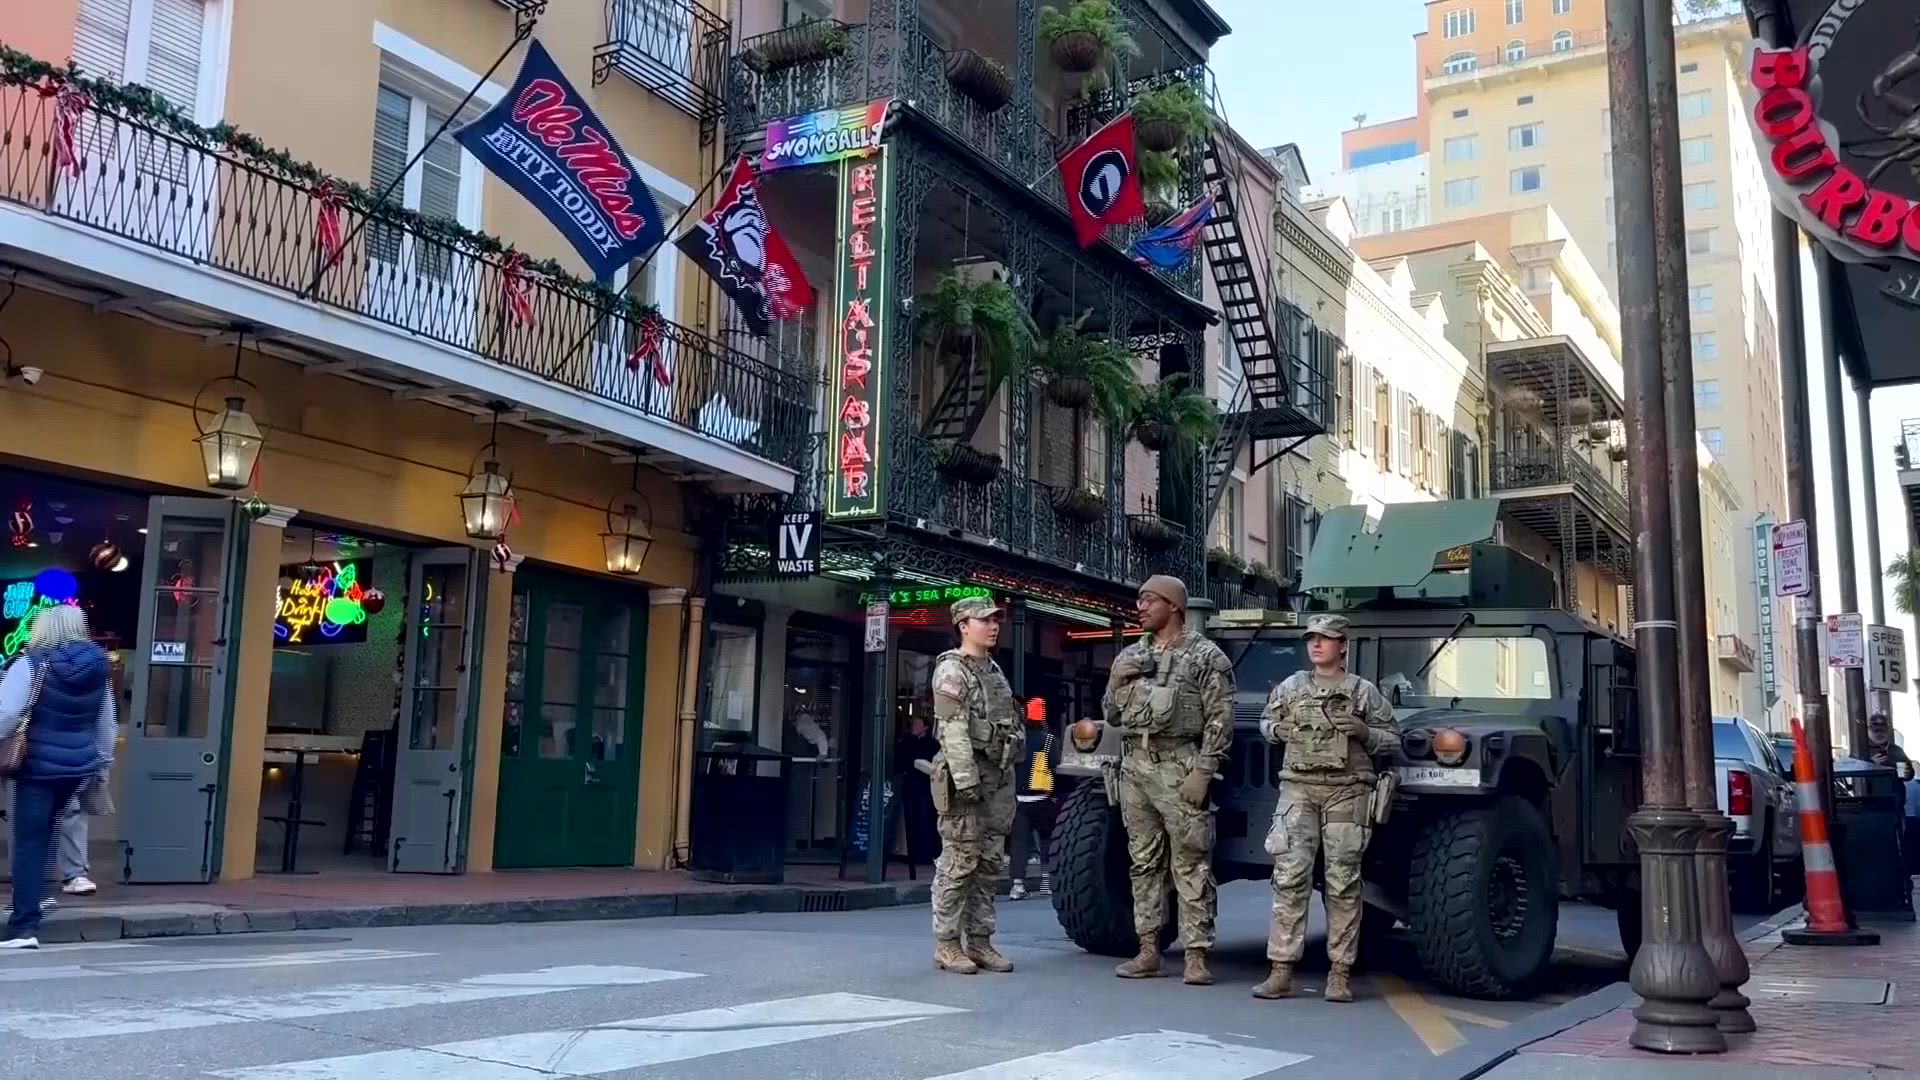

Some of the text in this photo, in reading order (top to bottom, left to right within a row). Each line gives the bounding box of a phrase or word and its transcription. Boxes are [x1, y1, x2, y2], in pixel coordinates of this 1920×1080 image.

[766, 122, 882, 161] SNOWBALLS
[556, 125, 646, 240] Miss
[551, 178, 621, 253] TODDY
[783, 513, 810, 524] KEEP
[779, 524, 813, 559] IV
[777, 560, 815, 573] WASTE
[915, 590, 940, 600] SEA
[154, 643, 184, 653] ATM
[1877, 645, 1901, 656] LIMIT
[1879, 659, 1901, 684] 15
